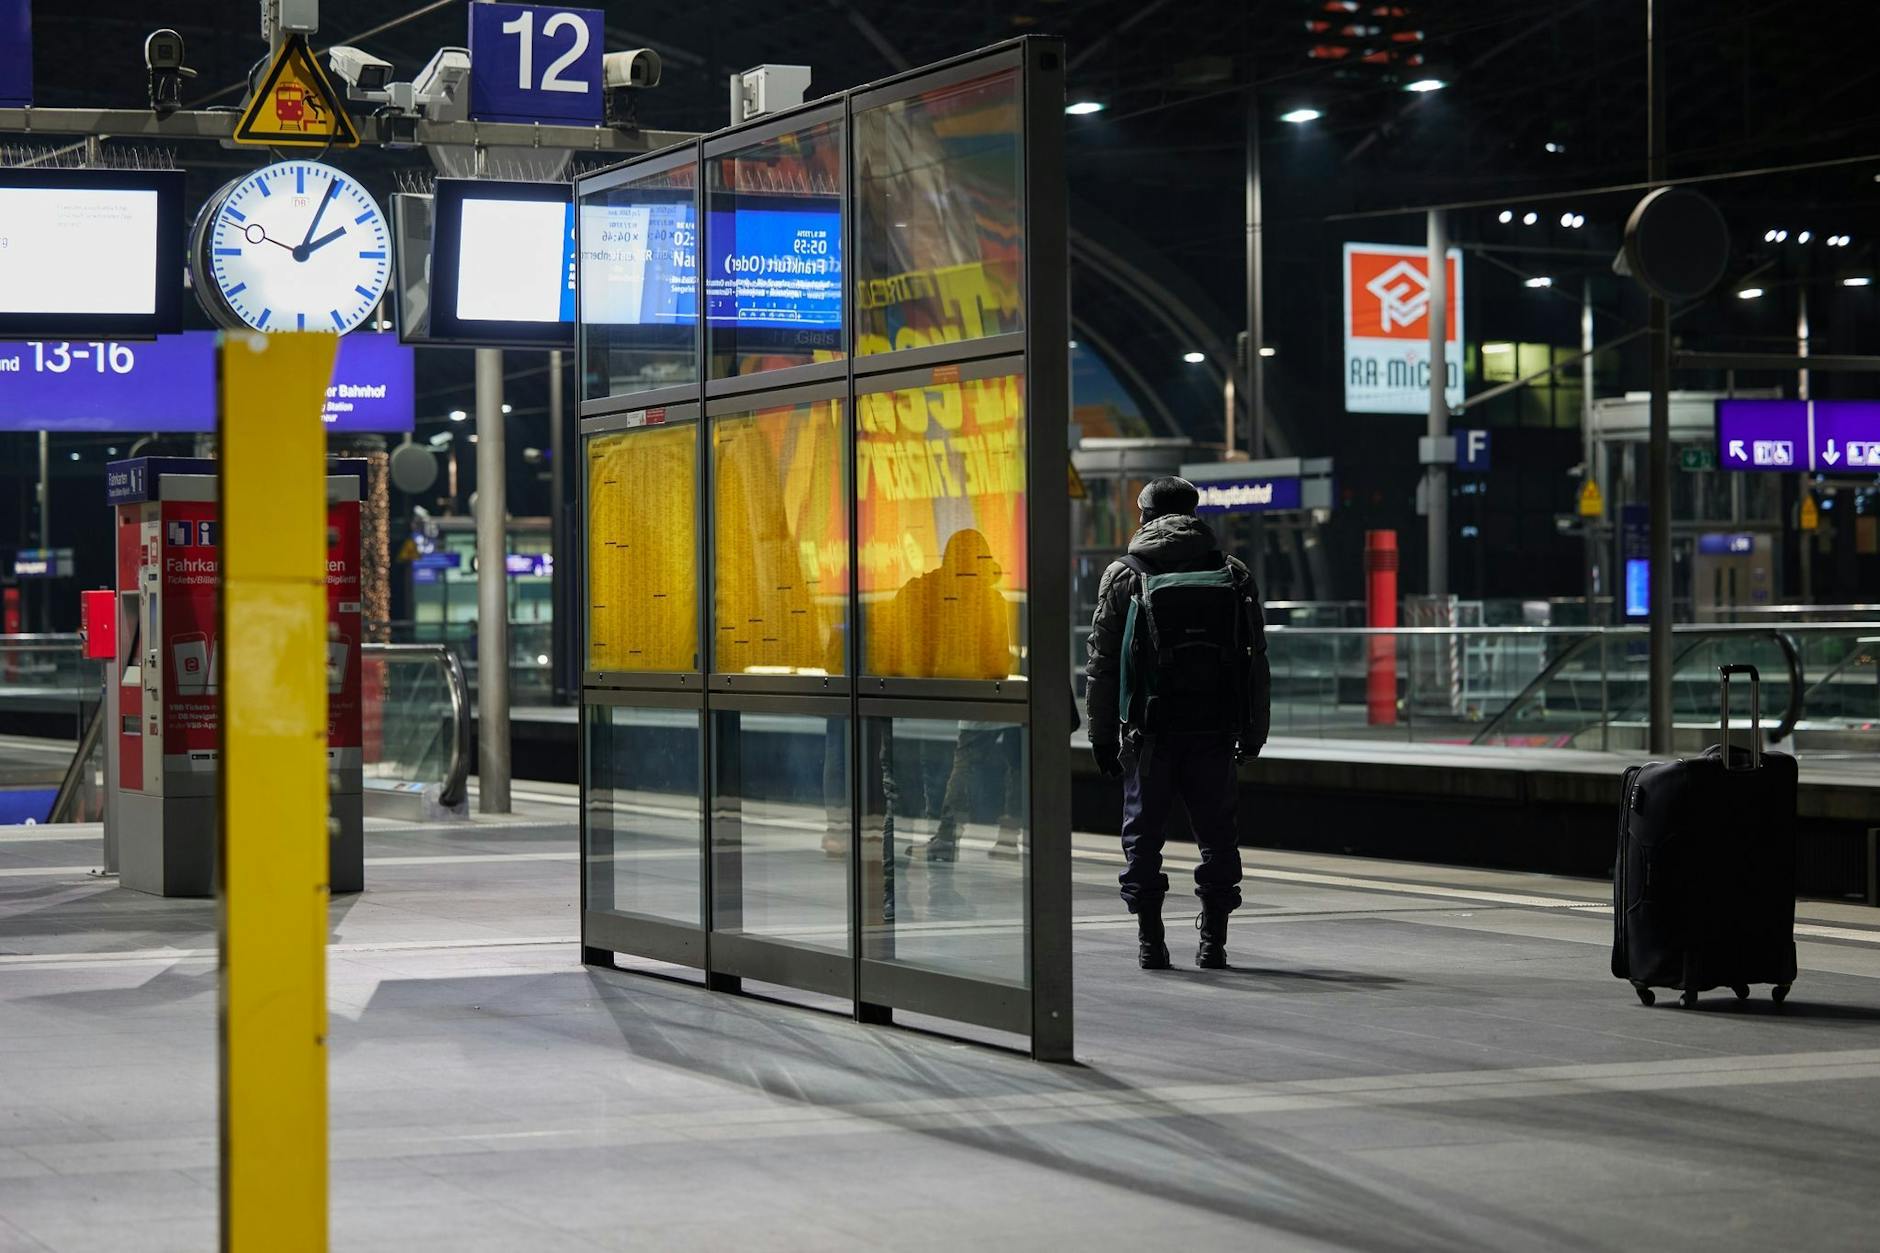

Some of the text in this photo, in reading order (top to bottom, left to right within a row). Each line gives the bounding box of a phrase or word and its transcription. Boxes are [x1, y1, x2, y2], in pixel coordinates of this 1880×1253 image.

[503, 11, 590, 93] 12
[294, 199, 306, 208] DB
[673, 231, 695, 247] 02:
[0, 341, 134, 374] nd 13-16
[338, 384, 387, 398] Bahnhof
[1468, 430, 1487, 463] F
[324, 558, 346, 572] ten
